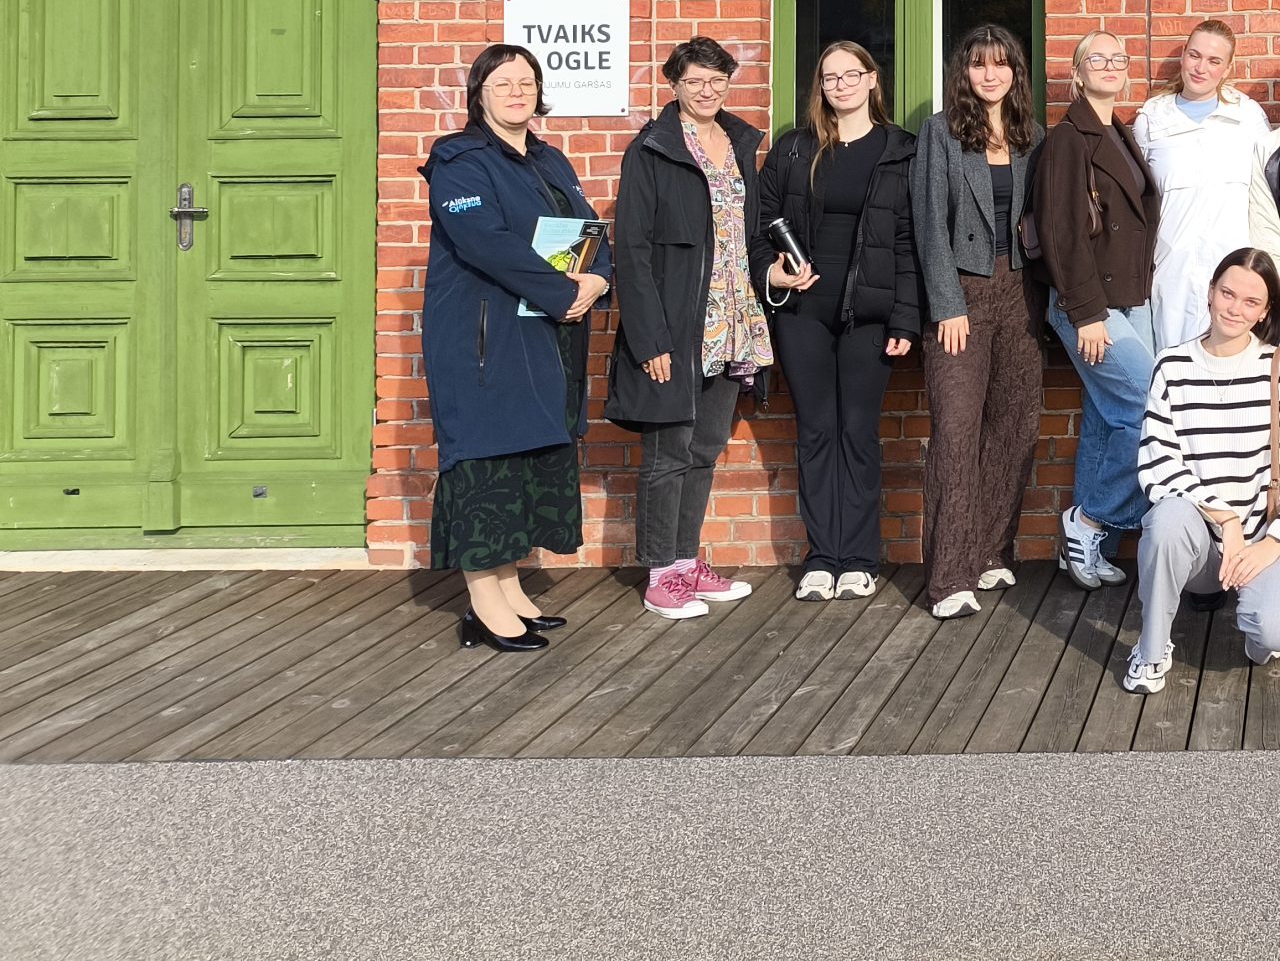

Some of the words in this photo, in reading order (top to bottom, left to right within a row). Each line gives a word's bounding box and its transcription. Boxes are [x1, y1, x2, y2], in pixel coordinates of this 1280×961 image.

[522, 24, 611, 44] TVAIKS
[546, 51, 611, 71] OGLE
[543, 81, 571, 89] JUMU
